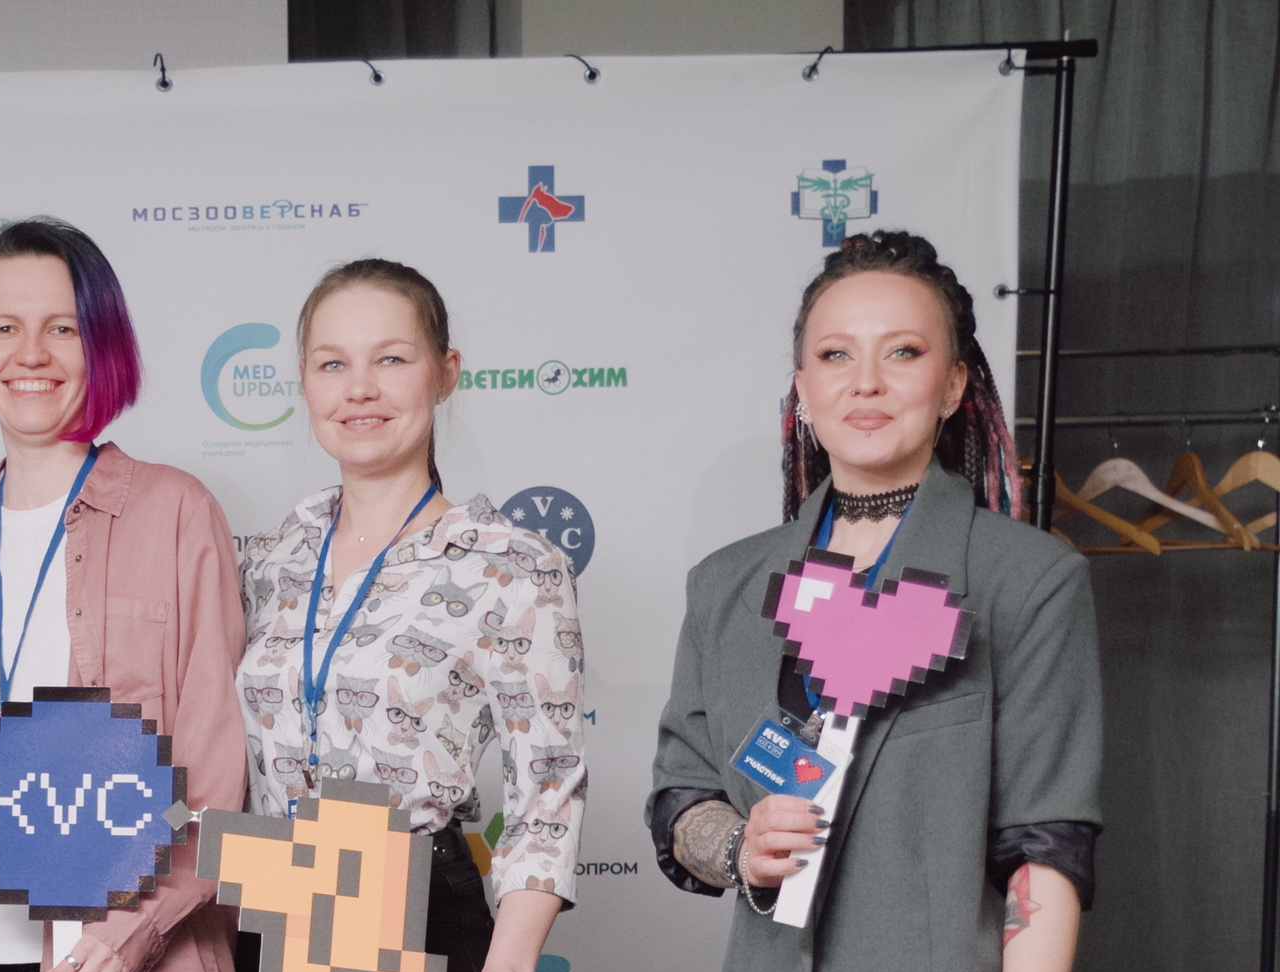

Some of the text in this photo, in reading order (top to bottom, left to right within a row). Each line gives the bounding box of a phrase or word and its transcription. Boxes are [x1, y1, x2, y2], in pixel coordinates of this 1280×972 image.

[132, 200, 368, 222] МОСЗООВЕТСНАБ
[233, 364, 276, 380] MED
[762, 727, 790, 750] KVC
[744, 755, 786, 787] УЧАСТНИК
